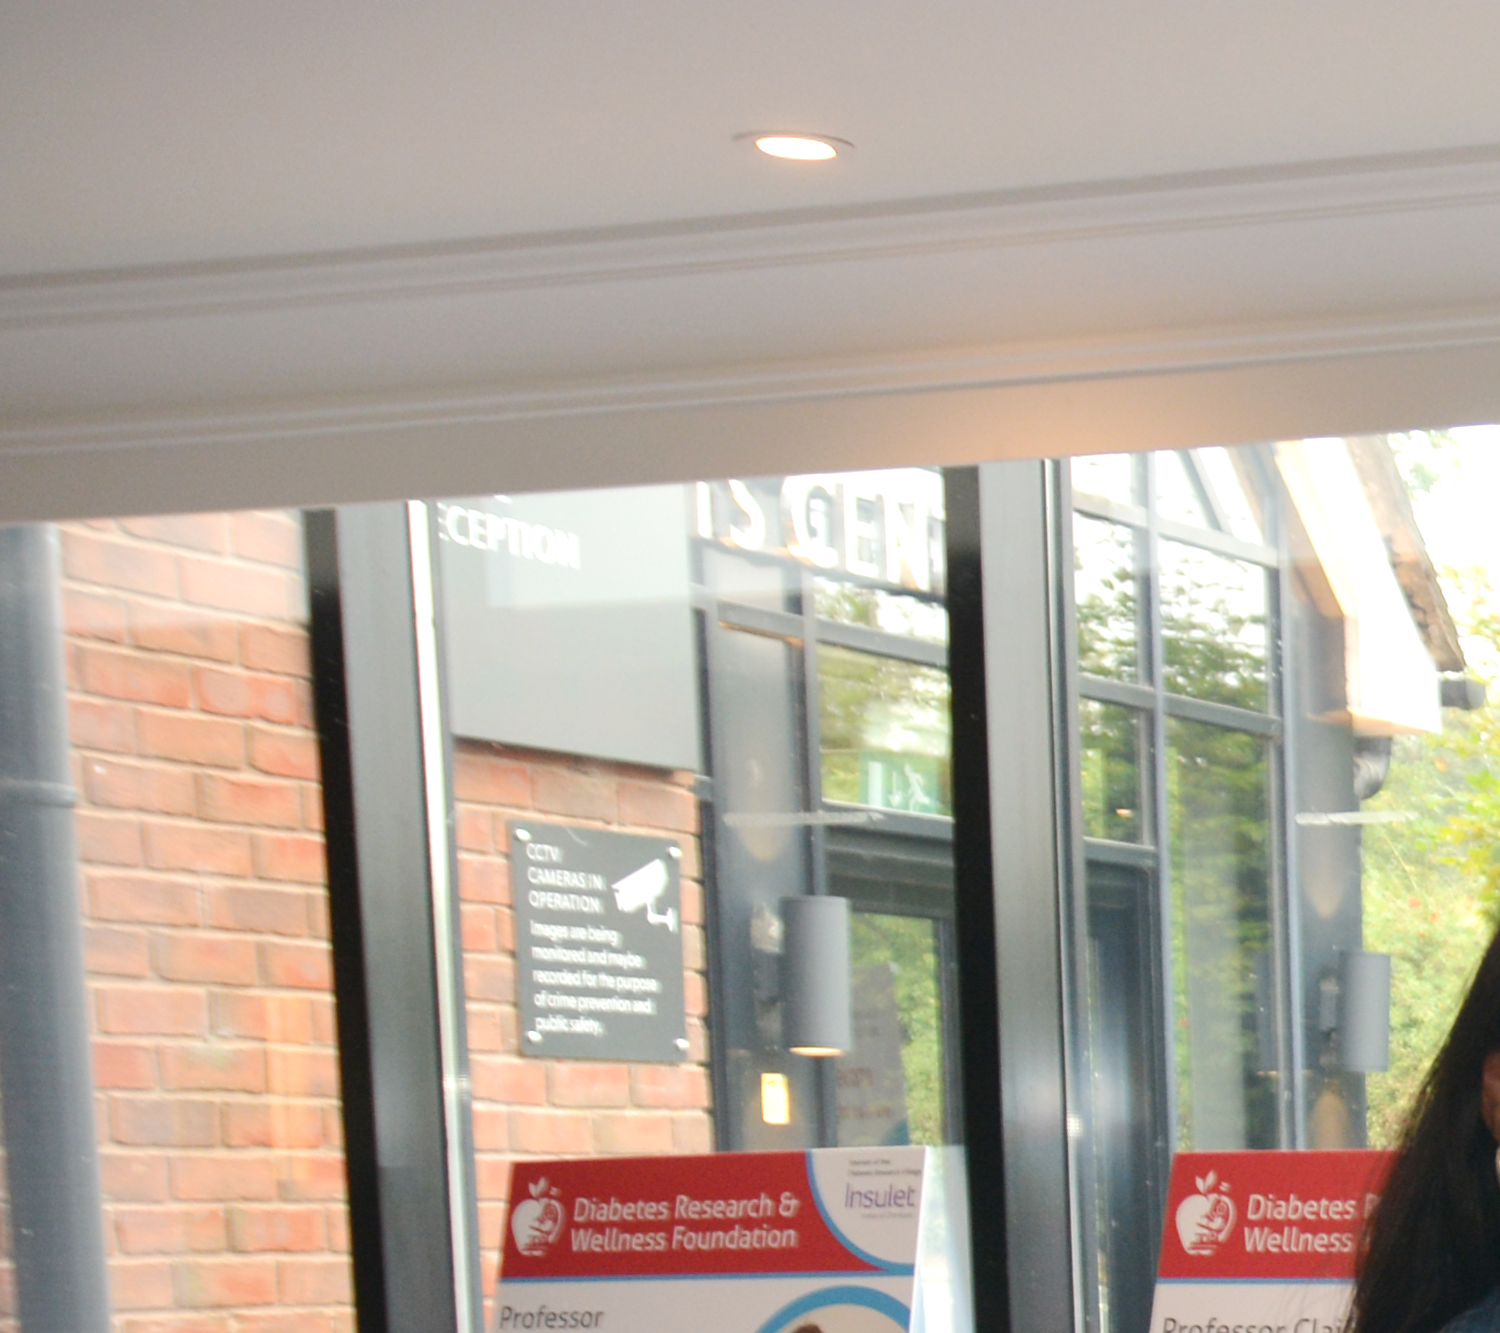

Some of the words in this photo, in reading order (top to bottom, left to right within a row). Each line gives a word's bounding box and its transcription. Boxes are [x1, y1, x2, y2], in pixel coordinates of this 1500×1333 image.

[526, 842, 560, 861] CCTV
[528, 867, 585, 888] CAMERAS
[588, 875, 603, 890] IN
[529, 891, 600, 912] OPERATION
[573, 1197, 670, 1222] Diabetes
[674, 1192, 775, 1220] Research
[778, 1191, 800, 1217] &
[844, 1183, 916, 1209] Insulet
[1247, 1193, 1356, 1220] Diabetes
[571, 1227, 668, 1252] Wellness
[671, 1223, 798, 1250] Foundation
[1244, 1226, 1353, 1253] Wellness
[499, 1304, 604, 1329] Professor
